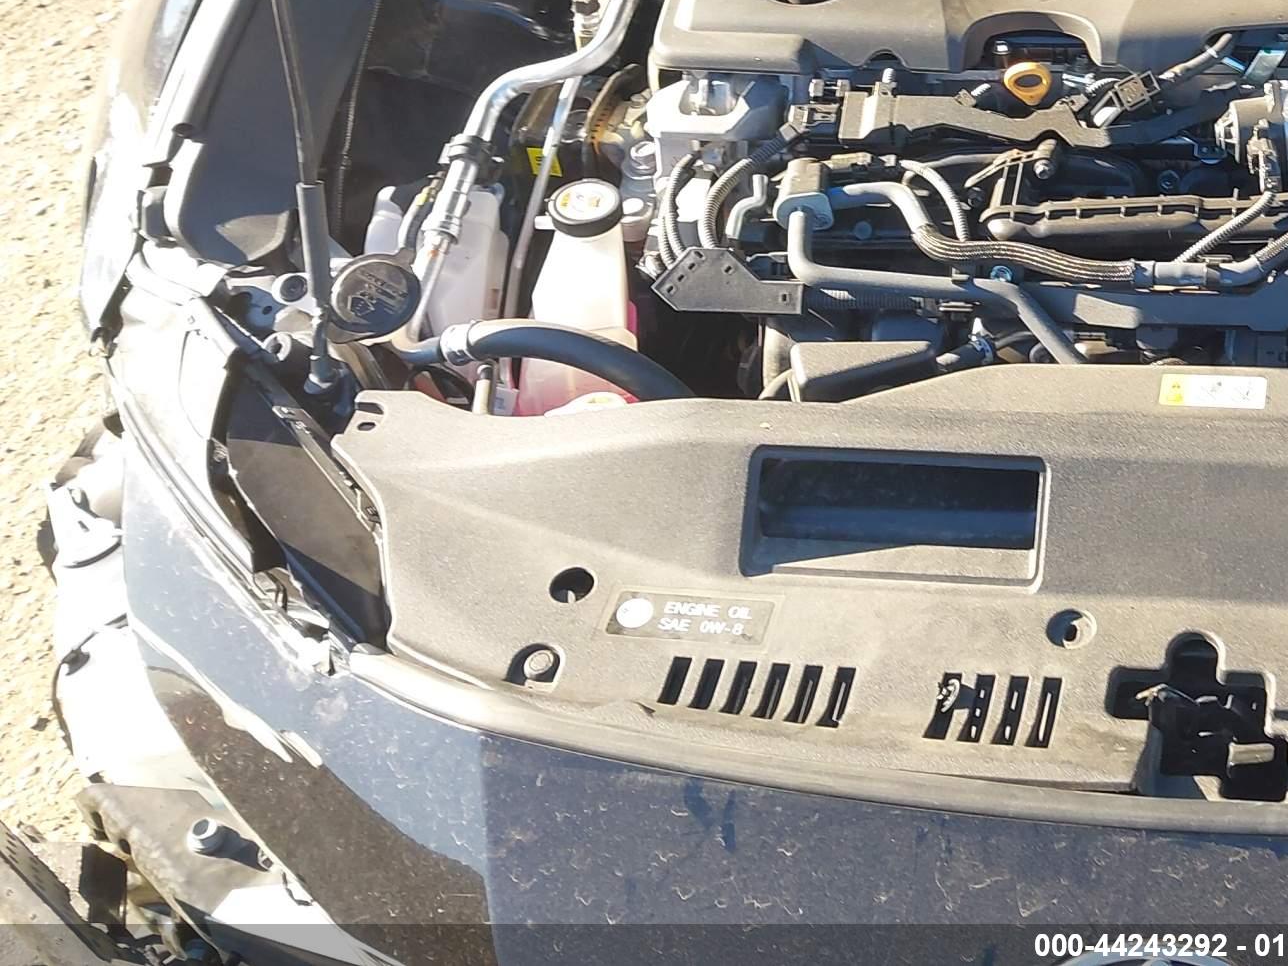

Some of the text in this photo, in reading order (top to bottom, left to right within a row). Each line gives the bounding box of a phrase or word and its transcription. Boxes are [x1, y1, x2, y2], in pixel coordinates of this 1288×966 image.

[663, 601, 753, 620] ENGINE OIL
[657, 617, 692, 632] SAE
